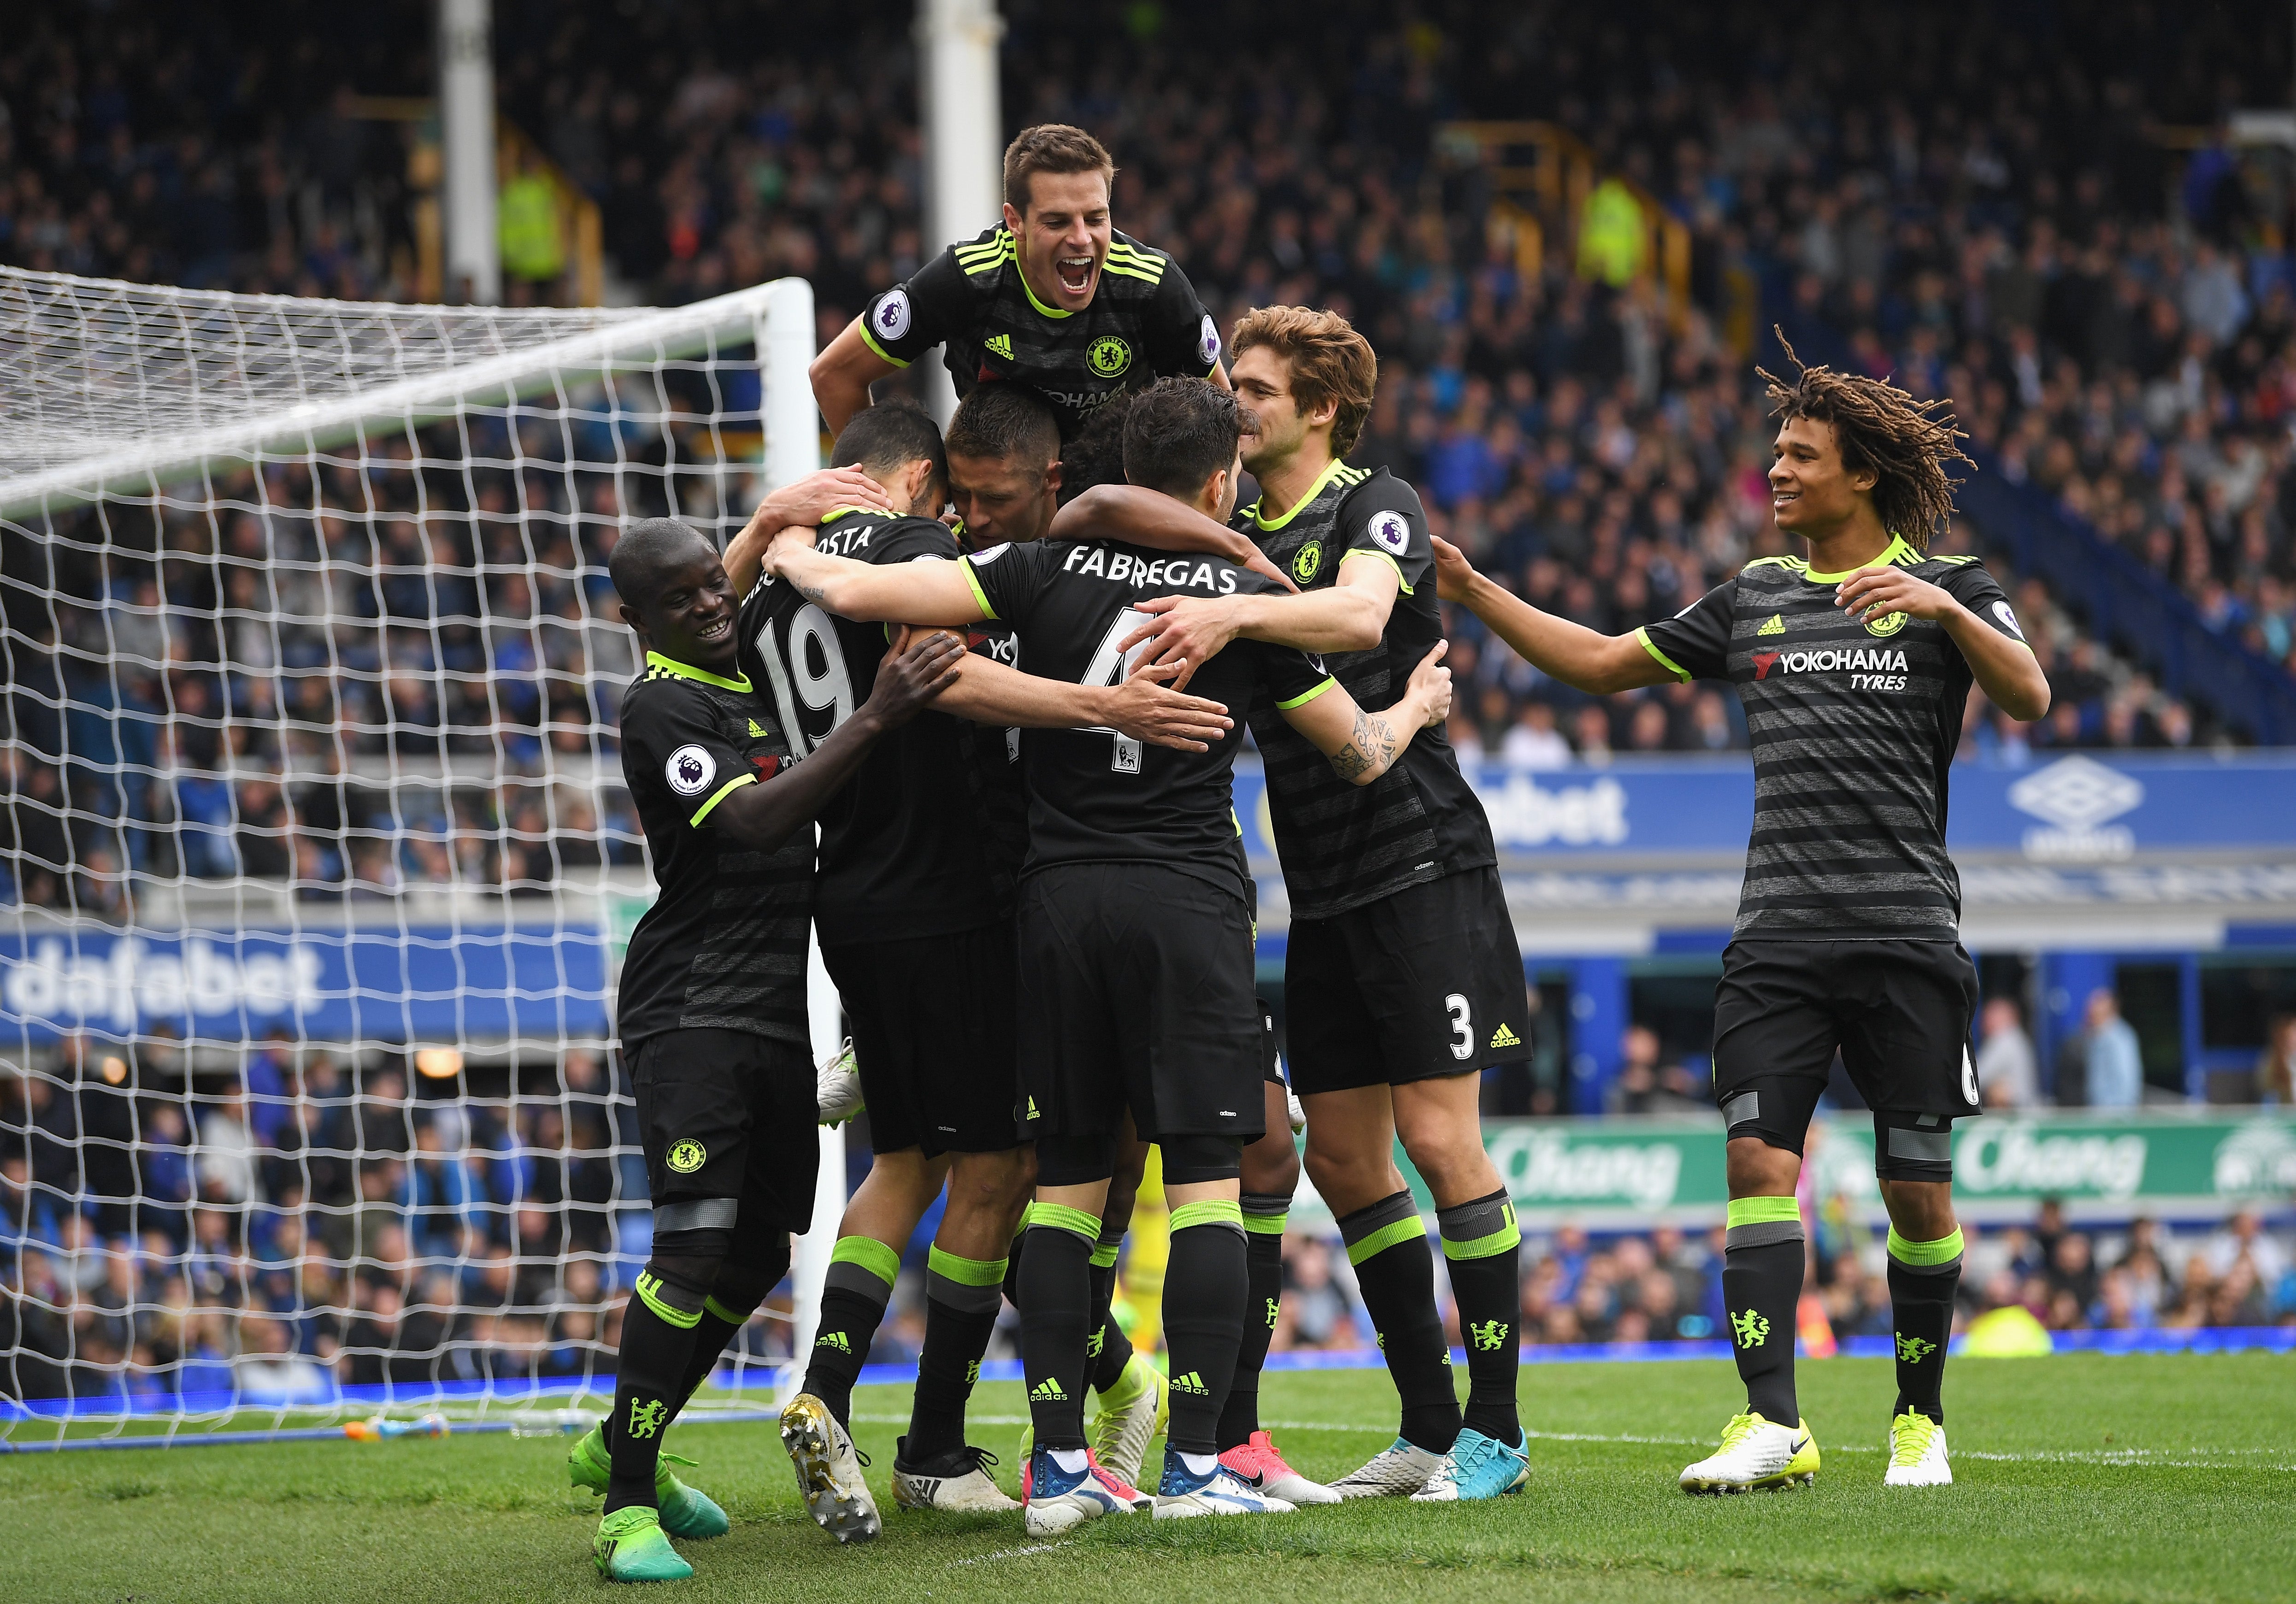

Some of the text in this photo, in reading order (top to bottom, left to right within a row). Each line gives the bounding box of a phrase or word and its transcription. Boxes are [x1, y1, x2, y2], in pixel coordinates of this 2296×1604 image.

[1094, 337, 1122, 347] CHELSEA
[984, 340, 1014, 360] adidas
[814, 526, 872, 555] OSTA
[1301, 543, 1320, 553] CHELSEA
[1757, 626, 1786, 636] adidas
[1780, 649, 1908, 673] YOKOHAMA
[754, 602, 855, 765] 19
[1851, 674, 1907, 690] TYRES
[749, 729, 768, 737] adidas
[673, 779, 686, 790] Premier
[1415, 861, 1434, 870] adizero
[5, 938, 323, 1031] dafabet
[1445, 993, 1474, 1060] 3
[1490, 1037, 1521, 1048] adidas
[1955, 1118, 2148, 1200] Chang
[1489, 1126, 1682, 1210] Chang
[816, 1339, 852, 1354] adidas
[1170, 1382, 1209, 1396] adidas
[1030, 1392, 1068, 1402] adidas
